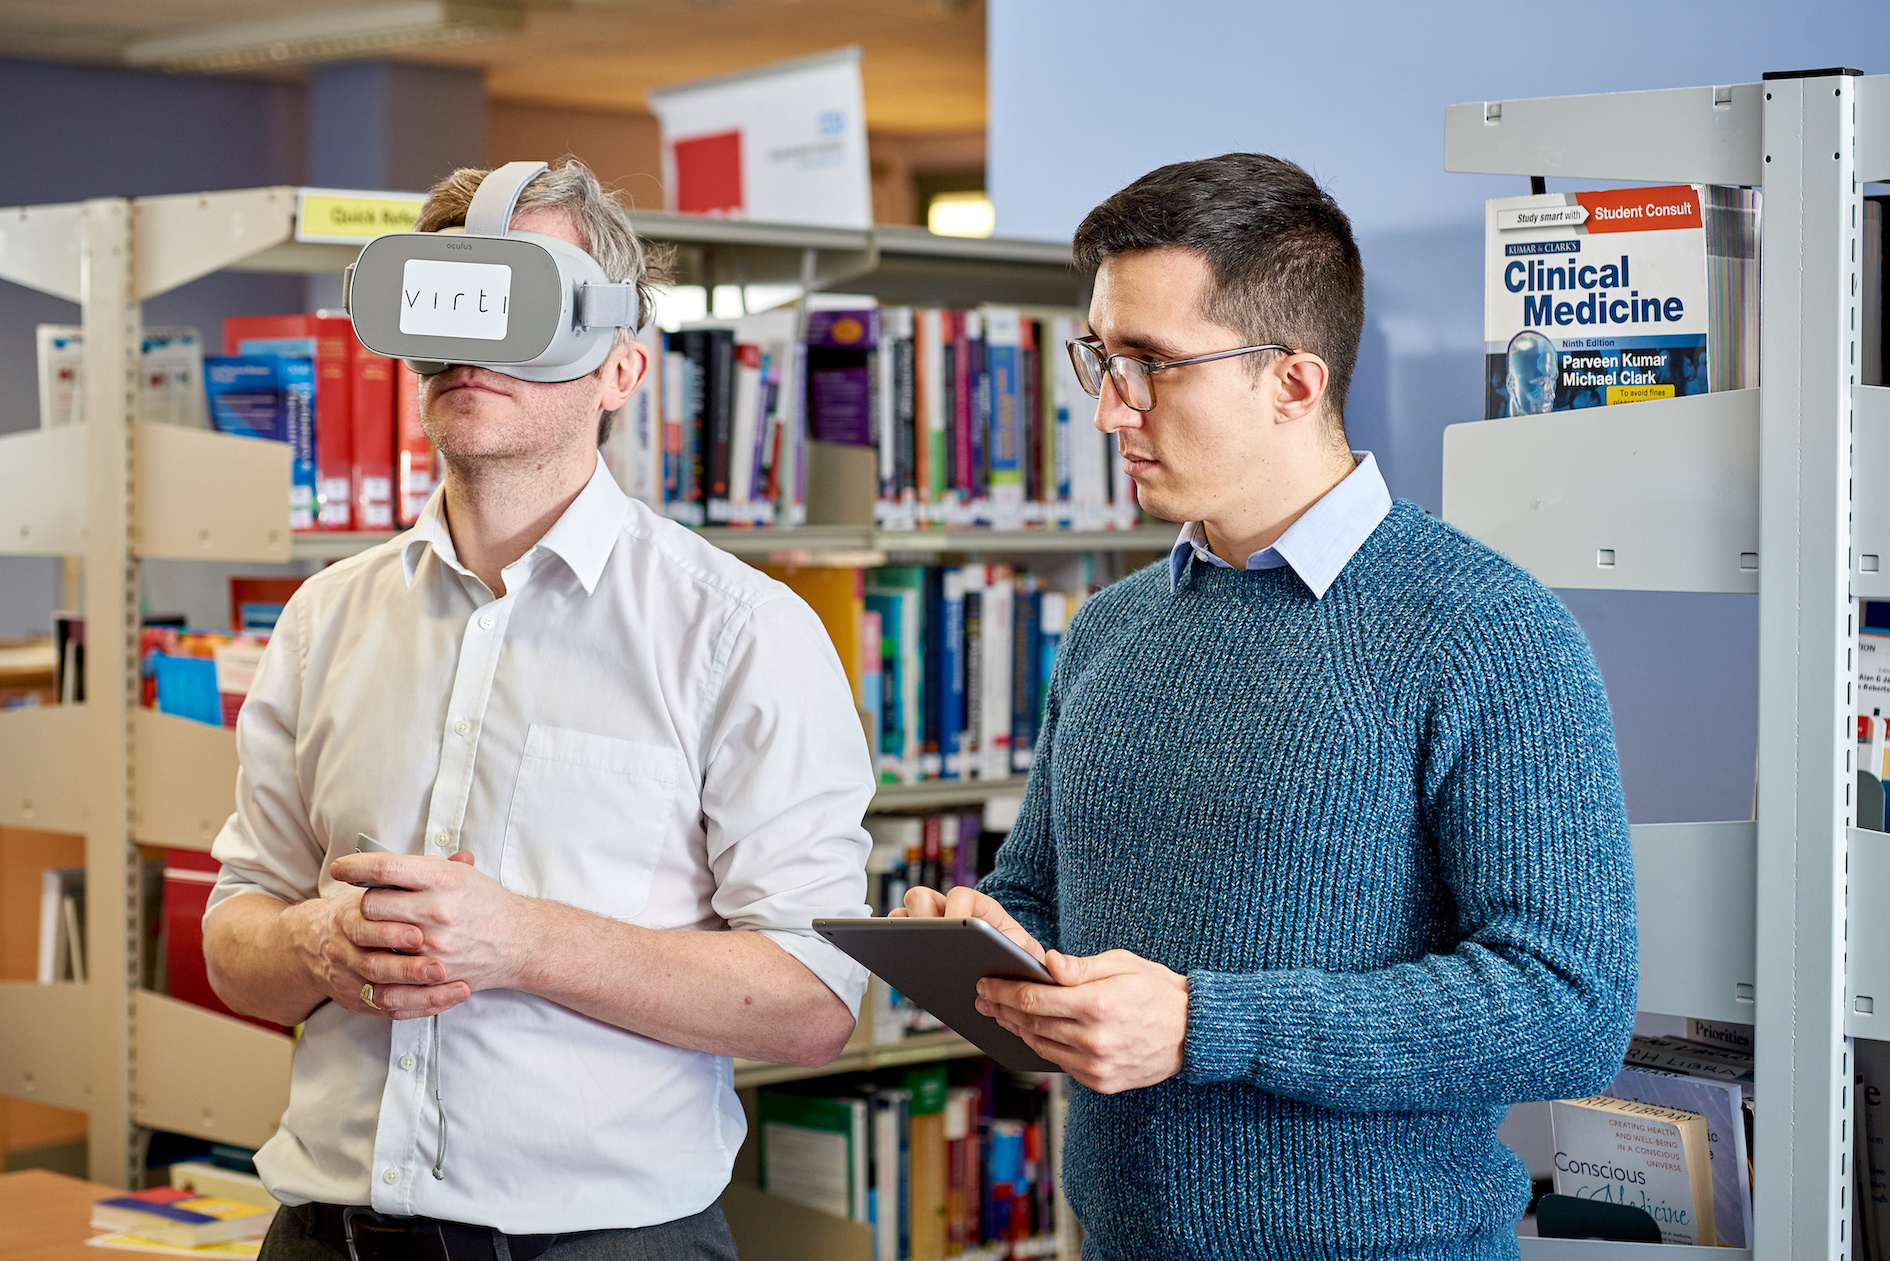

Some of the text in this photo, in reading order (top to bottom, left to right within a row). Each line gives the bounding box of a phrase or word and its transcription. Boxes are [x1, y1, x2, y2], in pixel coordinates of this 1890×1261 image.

[1517, 211, 1581, 224] Study smart with
[1595, 202, 1692, 221] Student Consult
[446, 242, 473, 250] oculus
[1508, 242, 1577, 255] KUMAR & CLARK'S
[1504, 255, 1629, 293] Clinical
[1524, 290, 1684, 327] Medicine
[1562, 338, 1615, 348] Ninth Edition
[1562, 352, 1667, 369] Parveen Kumar
[1562, 370, 1657, 387] Michael Clark
[1620, 388, 1666, 397] To avoid fines
[1695, 1020, 1750, 1047] Priorities
[1618, 1102, 1701, 1123] LIBRARY
[1608, 1119, 1676, 1137] CREATING HEALTH
[1615, 1132, 1678, 1149] AND WELL-BEING
[1617, 1143, 1626, 1151] IN
[1635, 1146, 1680, 1160] CONSCIOUS
[1554, 1151, 1646, 1185] Conscious
[1646, 1159, 1682, 1172] UNIVERSE
